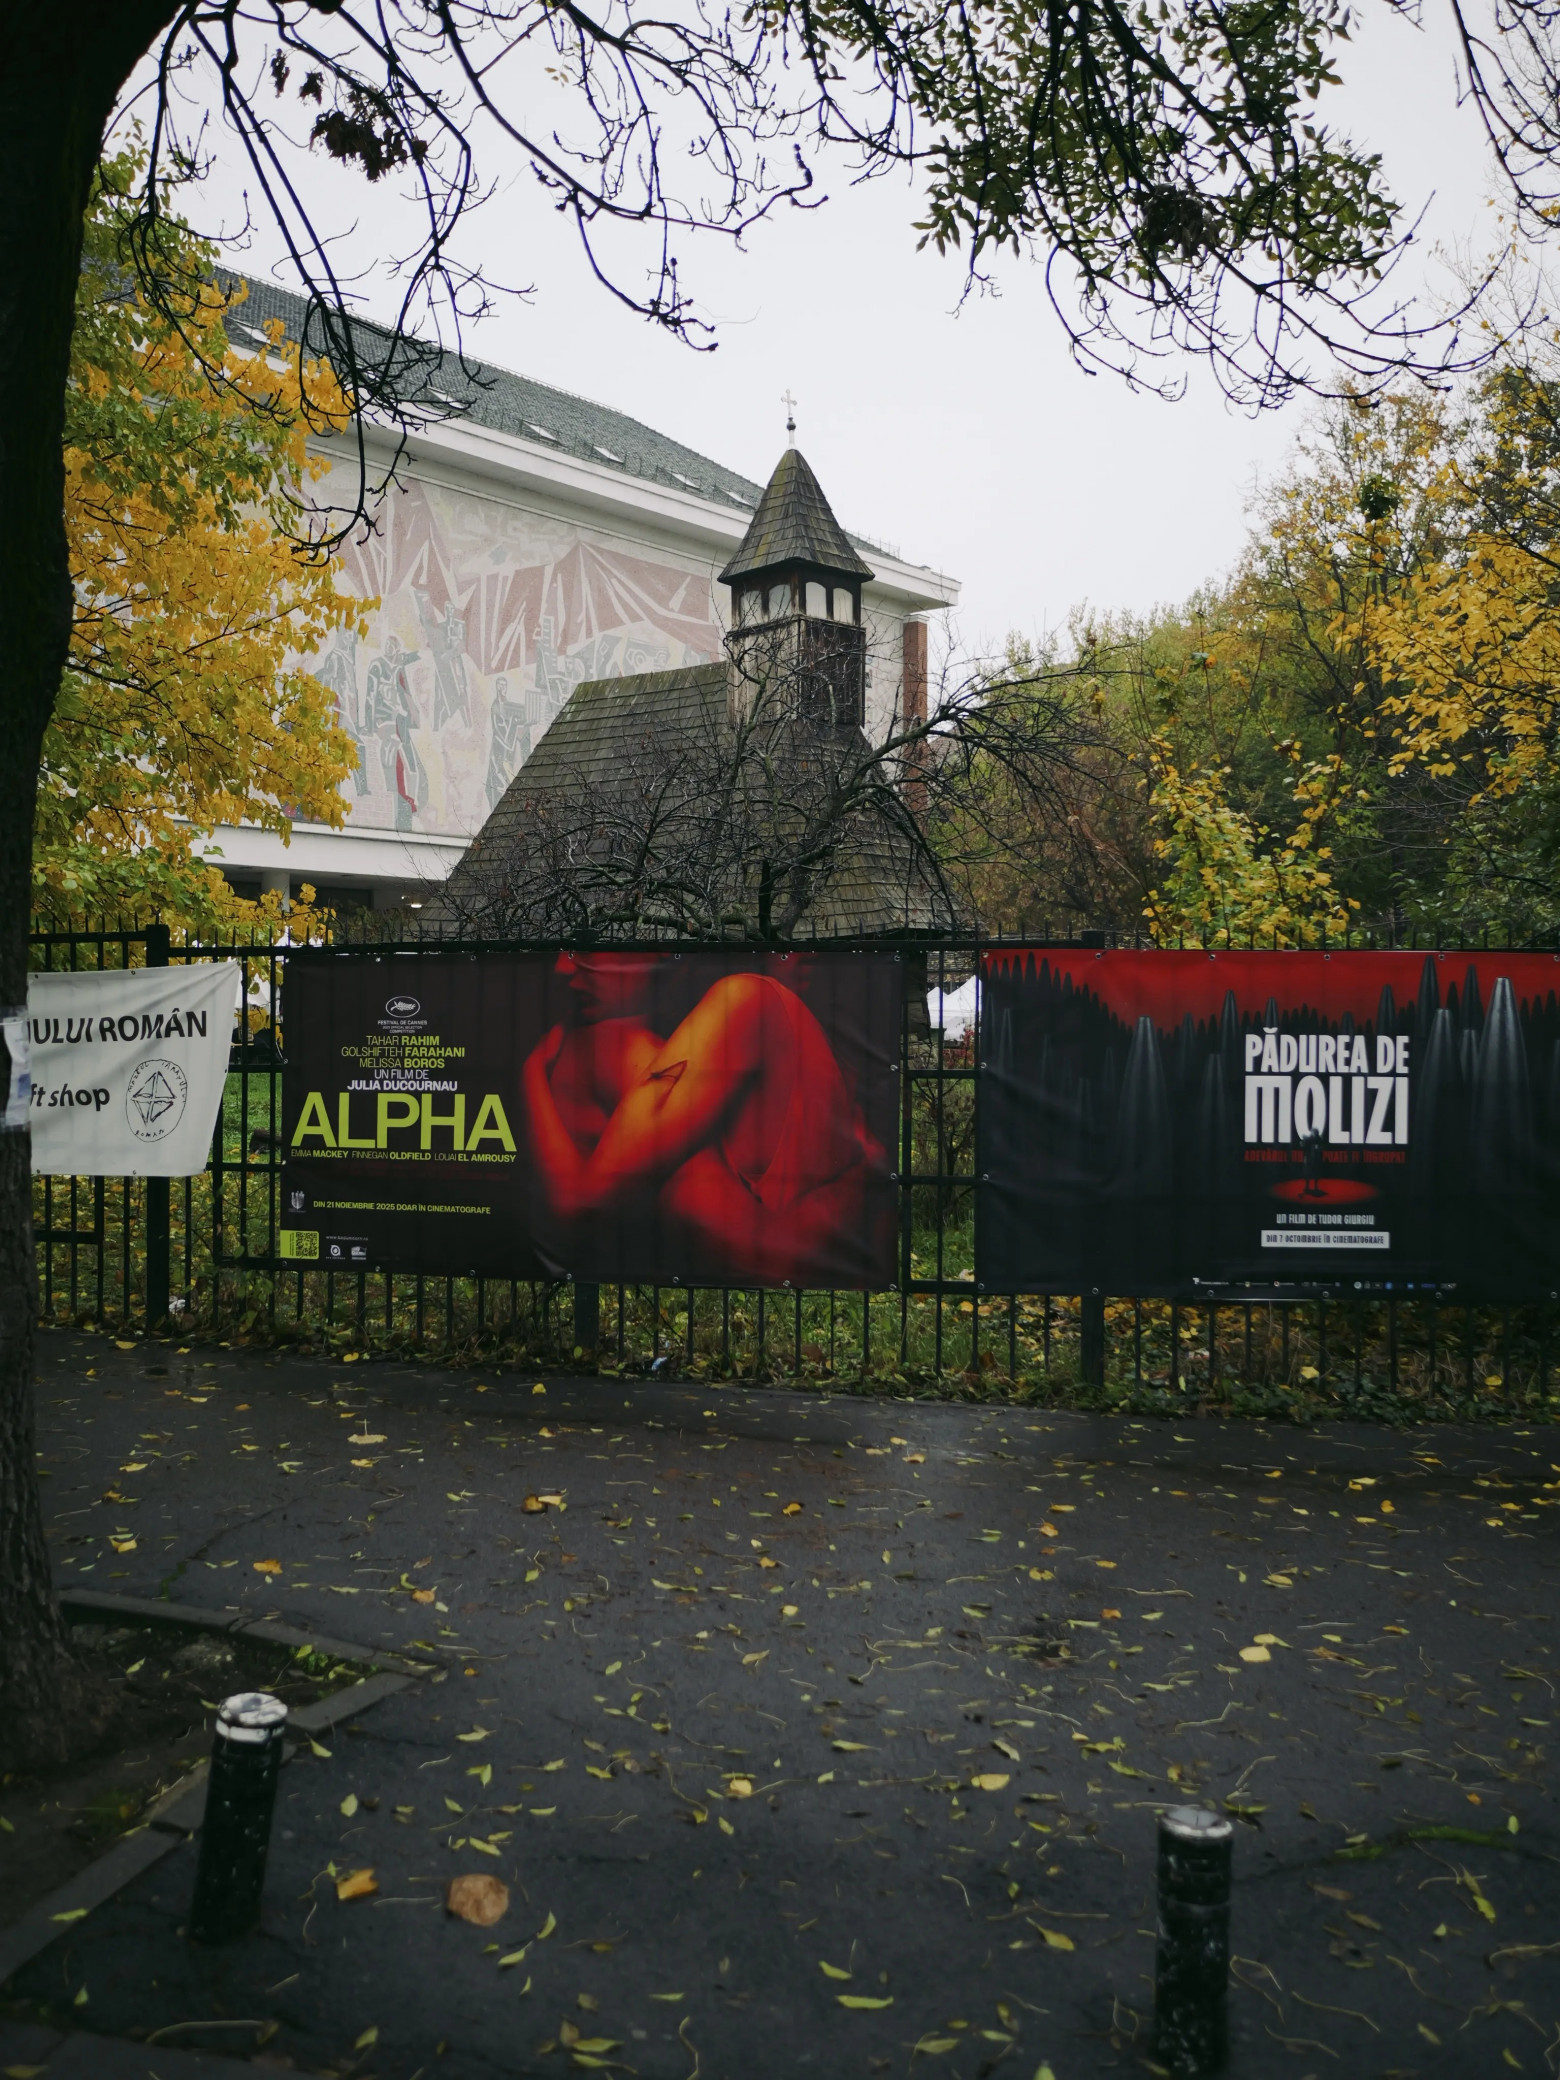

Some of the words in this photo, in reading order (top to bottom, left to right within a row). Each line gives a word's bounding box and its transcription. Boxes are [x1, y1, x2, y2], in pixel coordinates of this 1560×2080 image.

[27, 1018, 93, 1044] ULUI
[99, 1007, 207, 1042] ROMÂN
[366, 1035, 399, 1046] TAHAR
[401, 1036, 439, 1046] RAHIM
[341, 1046, 402, 1057] GOLSHIFTEH
[405, 1047, 465, 1057] FARAHANI
[1244, 1027, 1369, 1073] PĂDUREA
[1376, 1035, 1410, 1074] DE
[360, 1058, 401, 1068] MELISSA
[404, 1058, 445, 1068] BOROS
[374, 1069, 388, 1079] UN
[391, 1069, 413, 1079] FILM
[416, 1069, 429, 1079] DE
[347, 1080, 382, 1090] JULIA
[383, 1080, 458, 1091] DUCOURNAU
[48, 1083, 110, 1112] shop
[1244, 1075, 1409, 1145] MOLIZI
[290, 1091, 518, 1152] ALPHA
[291, 1149, 312, 1158] EMMA
[312, 1150, 349, 1159] MACKEY
[352, 1150, 389, 1160] FINNEGAN
[389, 1151, 432, 1161] OLDFIELD
[458, 1153, 469, 1162] EL
[471, 1153, 516, 1163] AMROUSY
[1322, 1150, 1348, 1163] POATE
[335, 1201, 375, 1210] NOIEMBRIE
[396, 1203, 417, 1211] DOAR
[418, 1203, 426, 1212] ÎN
[427, 1205, 491, 1214] CINEMATOGRAFE
[1276, 1214, 1287, 1224] UN
[1289, 1214, 1306, 1224] FILM
[1308, 1214, 1317, 1224] DE
[1319, 1214, 1342, 1224] TUDOR
[1344, 1214, 1375, 1225] GIURGIU
[1266, 1234, 1277, 1242] DIN
[1280, 1234, 1283, 1242] 7
[1286, 1234, 1321, 1243] OCTOMBRIE
[1324, 1234, 1330, 1243] ÎN
[1332, 1235, 1384, 1244] CINEMATOGRAFE
